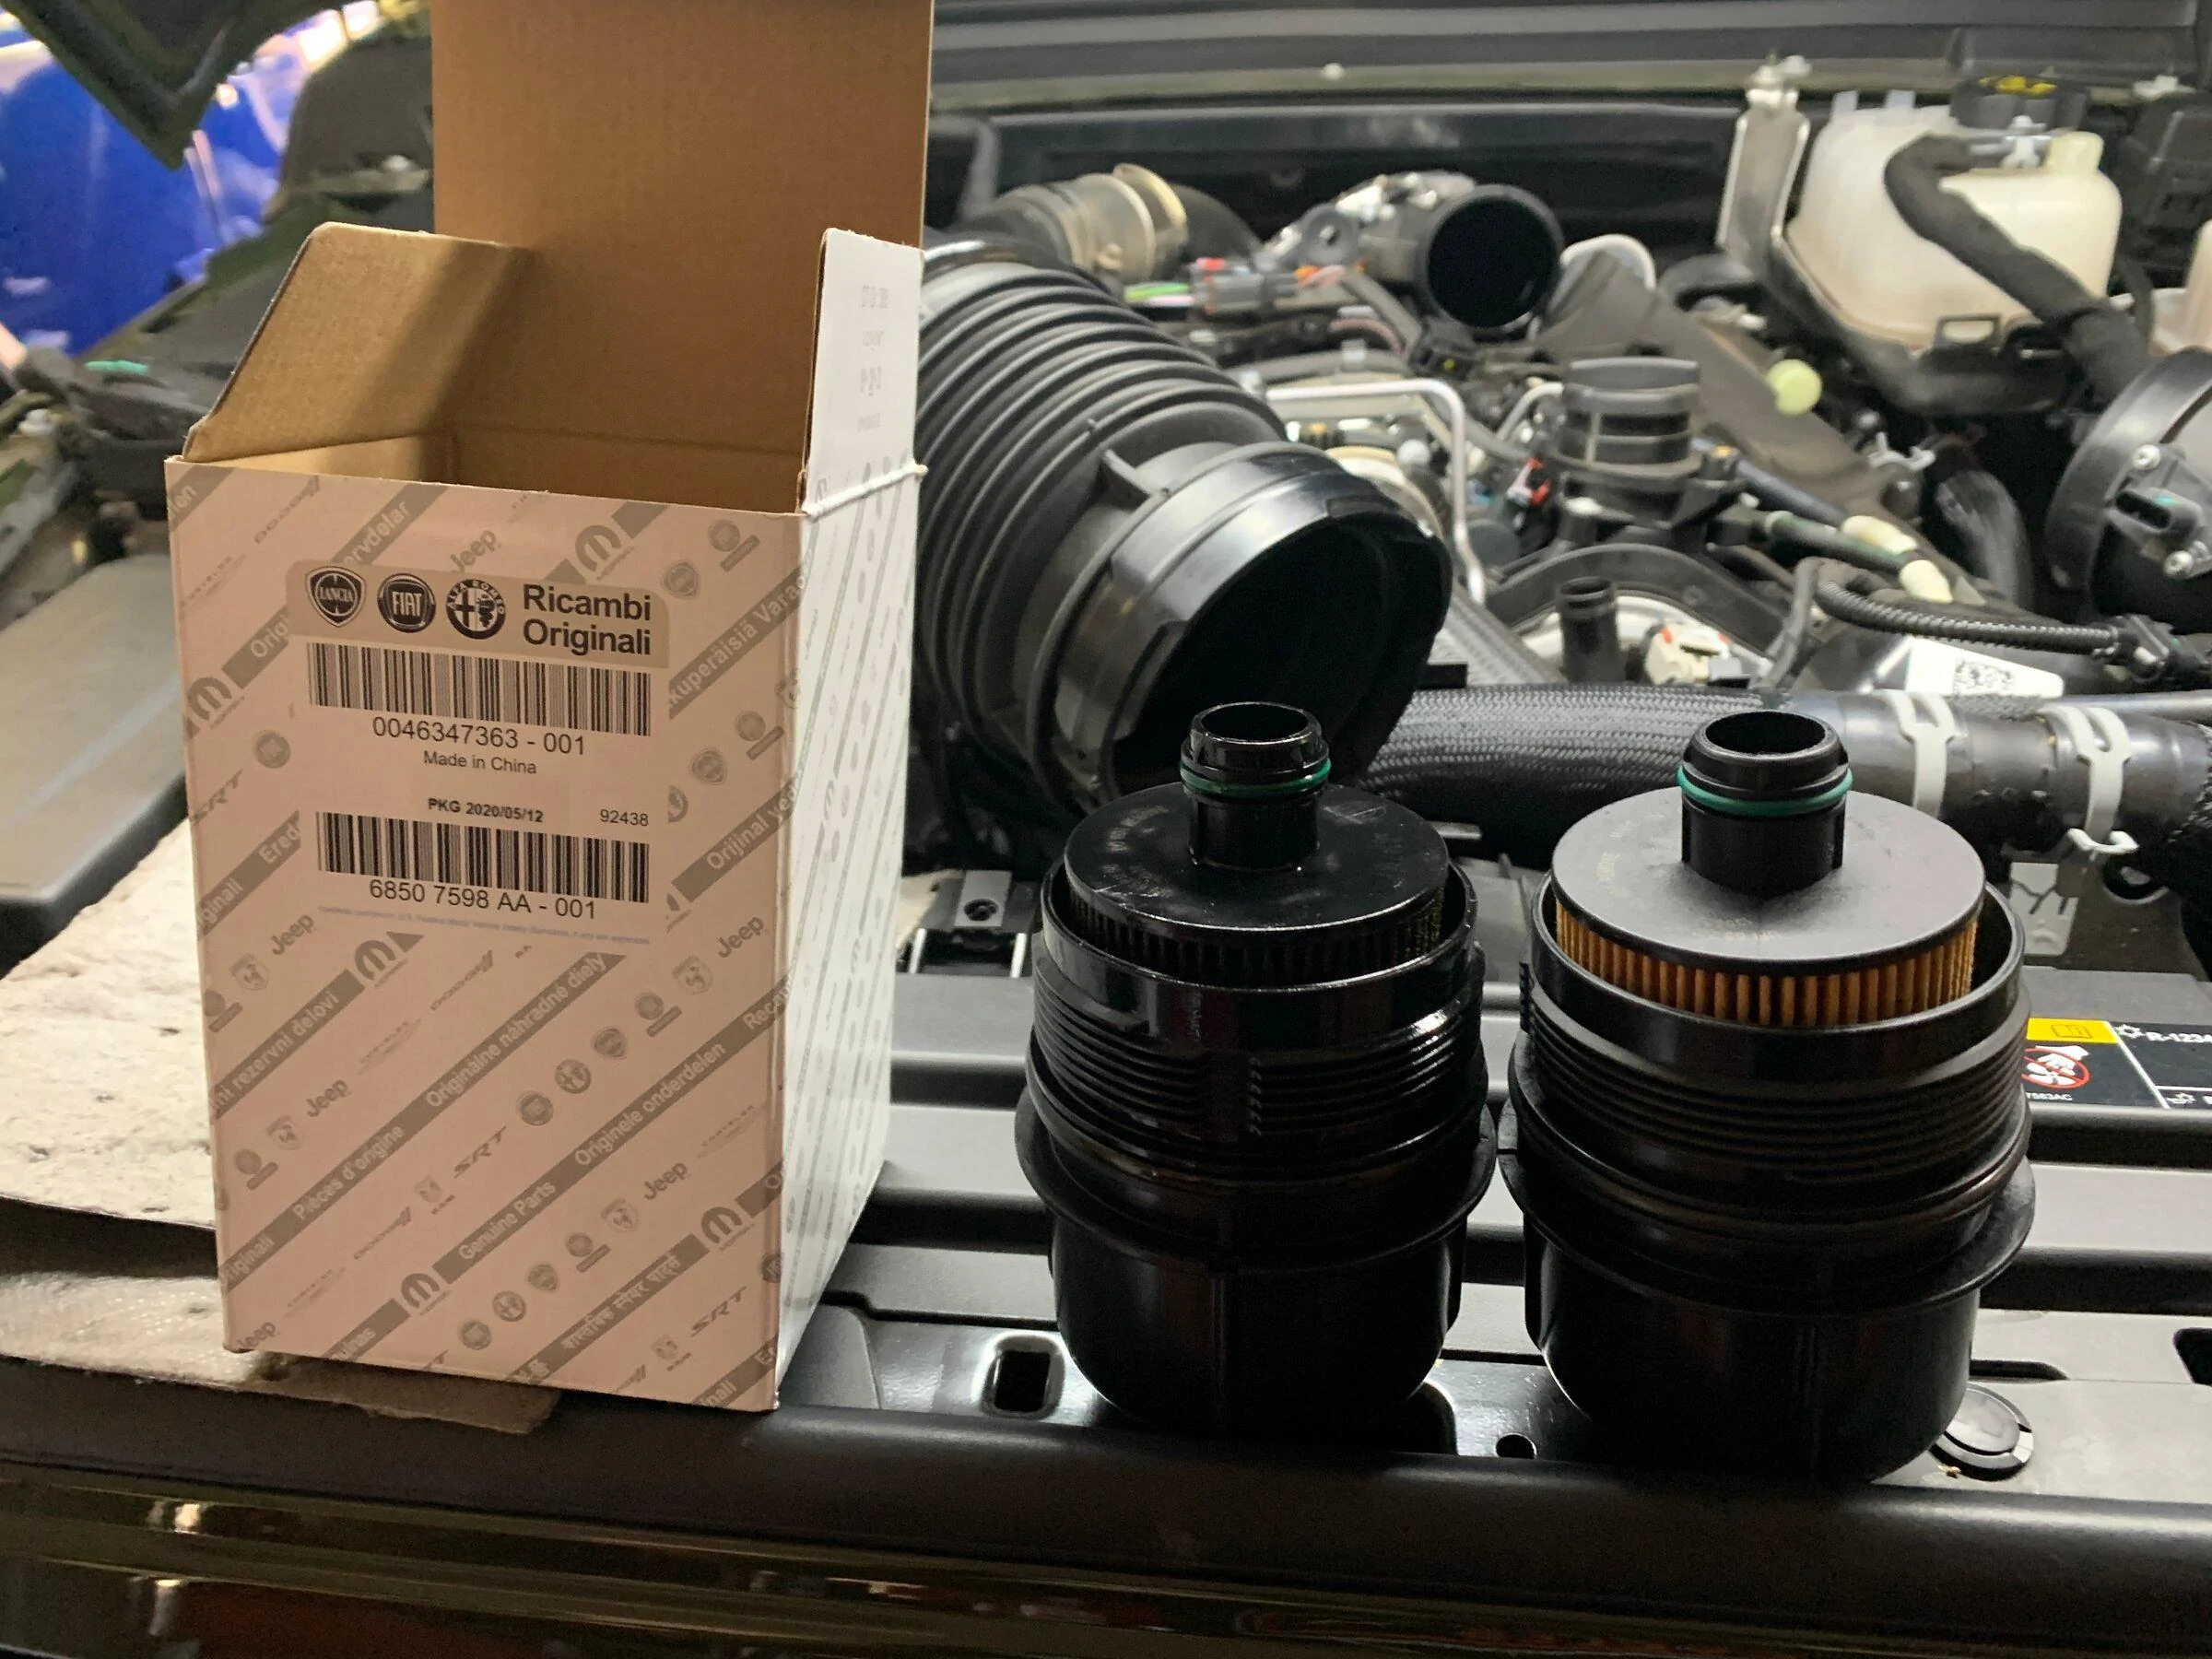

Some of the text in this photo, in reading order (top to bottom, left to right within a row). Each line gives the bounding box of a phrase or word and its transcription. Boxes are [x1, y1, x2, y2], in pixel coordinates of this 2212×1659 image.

[319, 586, 354, 602] LANCIA
[392, 591, 422, 617] FIAT
[523, 583, 651, 621] Ricambi
[523, 618, 651, 656] Originali
[371, 716, 519, 748] 0046347363
[543, 732, 585, 756] 001
[423, 750, 537, 774] Made in China
[428, 798, 544, 823] PKG 2020/05/12
[599, 808, 649, 827] 92438
[370, 878, 426, 903] 6850
[433, 885, 489, 910] 7598
[497, 890, 532, 913] AA
[555, 897, 595, 920] 001
[271, 914, 315, 956] Jeep
[717, 915, 765, 959] Jeep
[306, 1078, 350, 1118] Jeep
[574, 1109, 644, 1166] Originele
[642, 1043, 726, 1112] onderdelen
[644, 1162, 688, 1200] Jeep
[459, 1212, 518, 1260] Genuine
[513, 1182, 556, 1217] Parts
